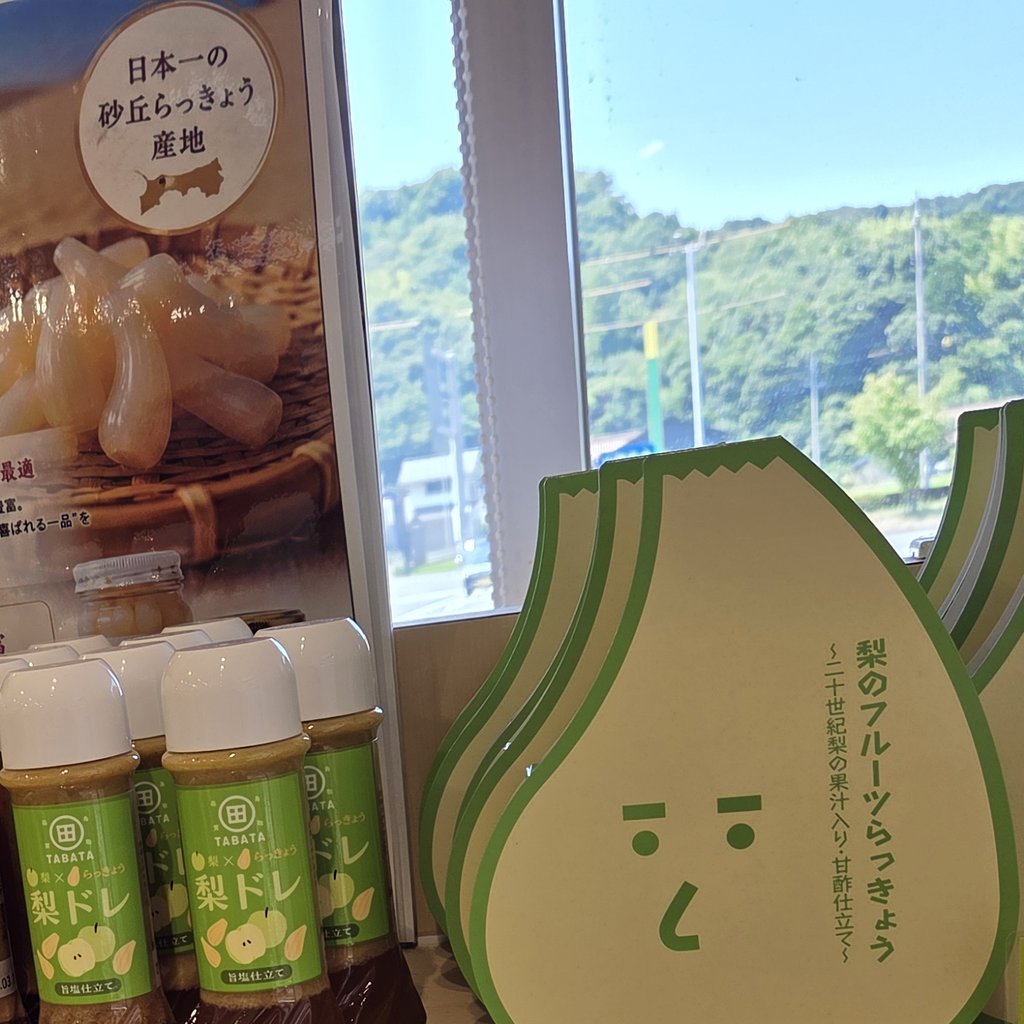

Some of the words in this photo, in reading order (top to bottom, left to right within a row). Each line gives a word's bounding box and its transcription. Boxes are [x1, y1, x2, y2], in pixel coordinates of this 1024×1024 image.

[127, 45, 229, 85] 日本一の
[97, 77, 255, 129] 砂丘らっきょう
[151, 126, 206, 161] 産地
[855, 637, 899, 963] 梨のフルーツらっきょう
[45, 849, 95, 865] TABATA
[214, 831, 266, 848] TABATA
[31, 886, 131, 926] 梨ドレ
[194, 870, 302, 912] 梨ドレ
[228, 965, 285, 983] 旨塩仕立て
